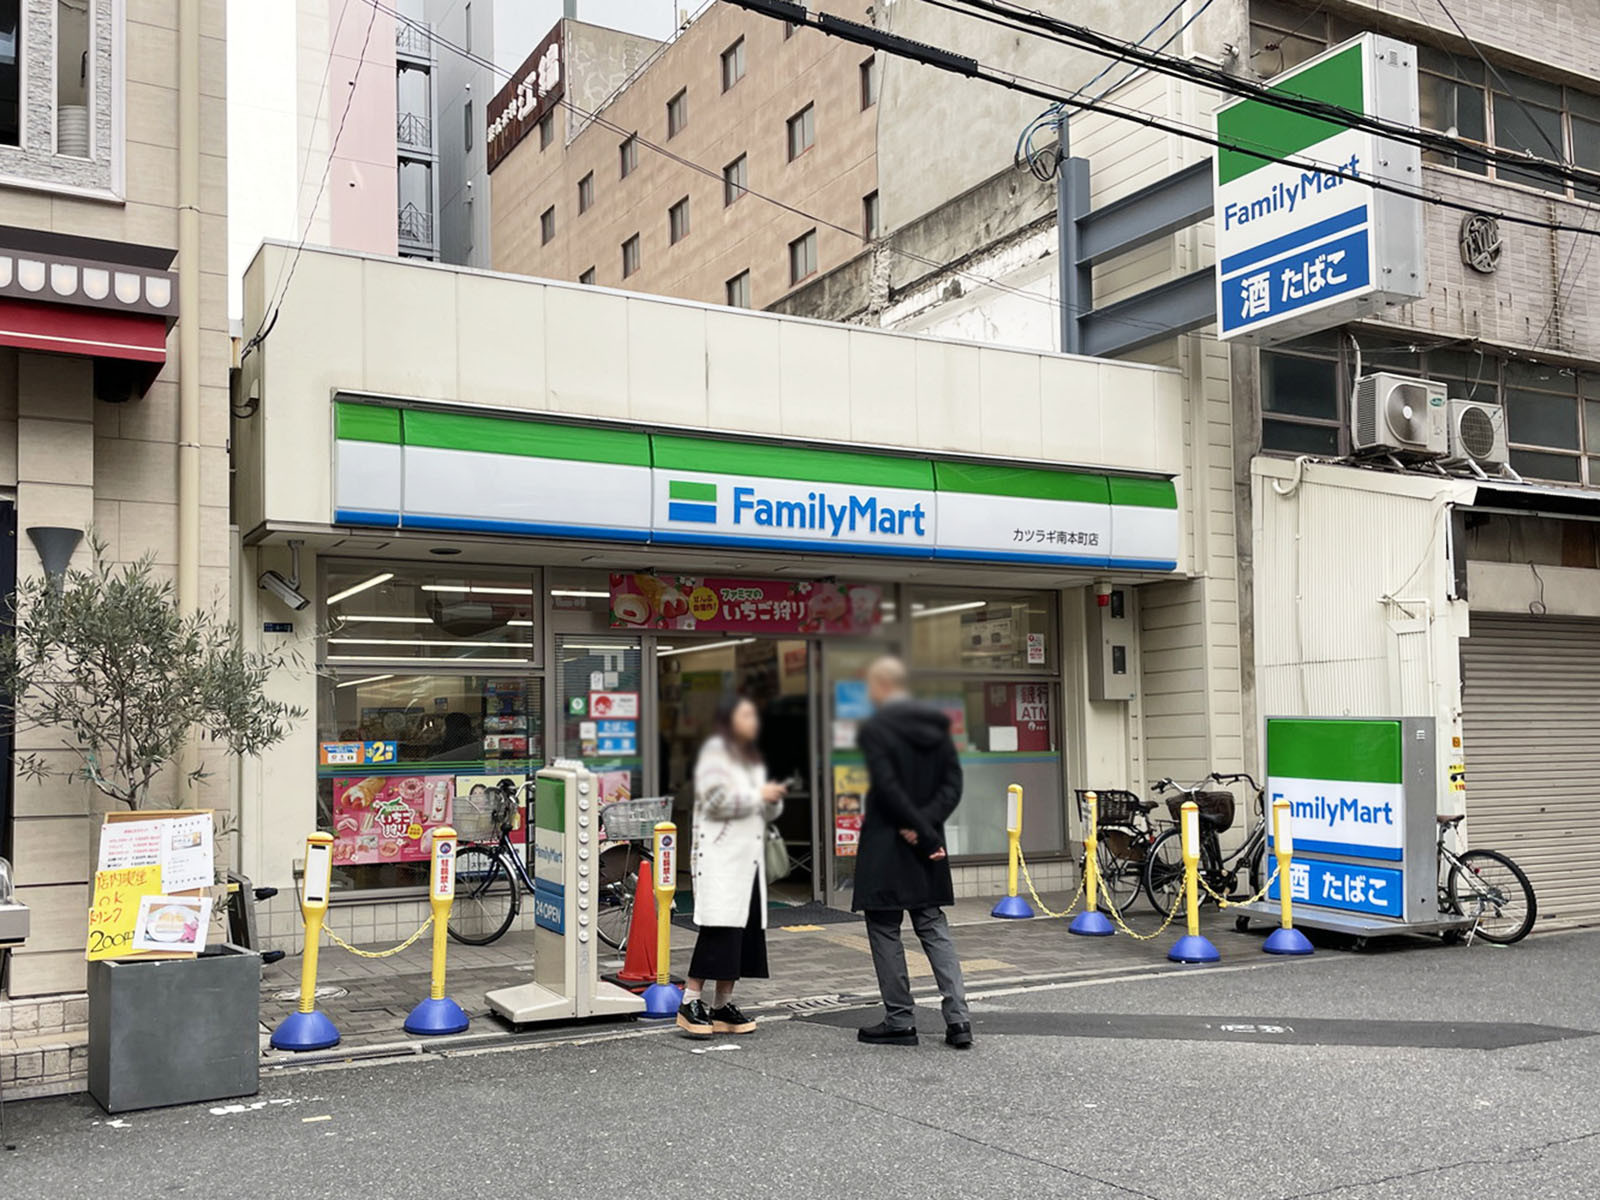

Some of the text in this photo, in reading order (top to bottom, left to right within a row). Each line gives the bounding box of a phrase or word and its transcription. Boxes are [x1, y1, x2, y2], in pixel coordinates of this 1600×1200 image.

[1224, 153, 1361, 231] FamilyMart
[1240, 249, 1348, 319] 酒 たばこ
[733, 486, 926, 537] FamilyMart
[1013, 527, 1099, 546] カツラギ南本町店
[720, 587, 764, 603] ファミマの
[722, 600, 805, 622] いちご狩り
[1020, 686, 1049, 704] 銀行
[380, 809, 414, 825] いちご
[1272, 793, 1393, 827] milyMart
[534, 844, 563, 864] FamilyMart
[1322, 872, 1388, 906] たばこ
